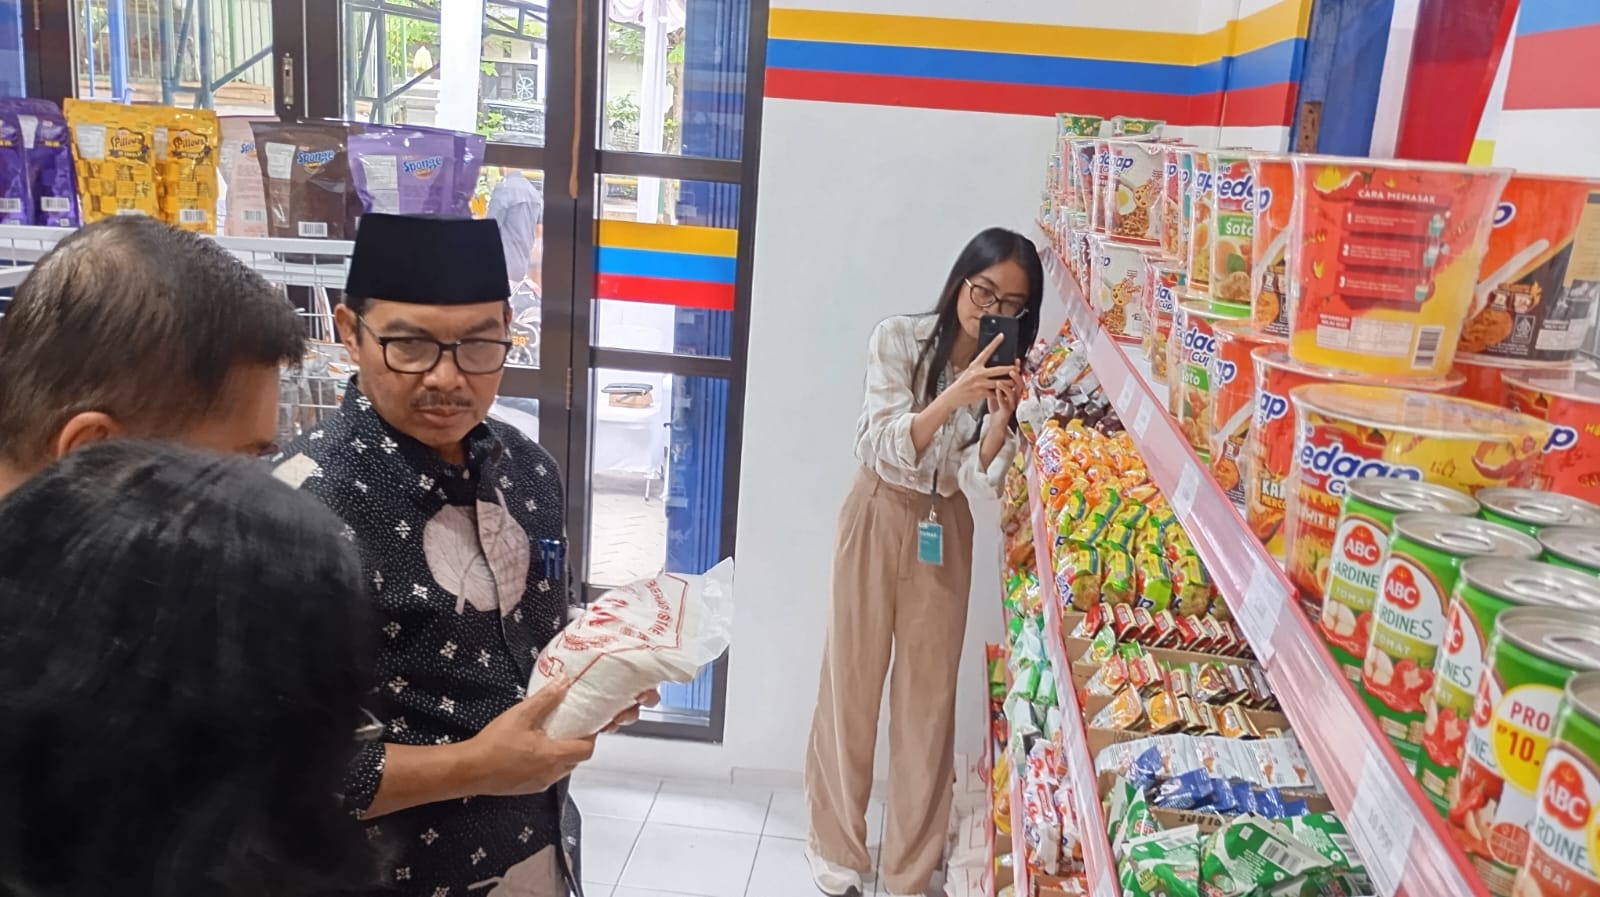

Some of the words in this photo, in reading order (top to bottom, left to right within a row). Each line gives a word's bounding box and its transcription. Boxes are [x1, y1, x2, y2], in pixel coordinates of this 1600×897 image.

[298, 150, 335, 164] Sponge
[402, 156, 442, 173] Sponge
[1358, 189, 1384, 200] CARA
[1387, 191, 1436, 204] MEMASAK
[1346, 211, 1353, 225] 1
[1342, 243, 1350, 257] 2
[1344, 537, 1378, 561] ABC
[1335, 561, 1380, 590] ARDINE
[1385, 577, 1418, 605] ABC
[1381, 605, 1434, 641] RDINES
[1545, 778, 1588, 821] ABC
